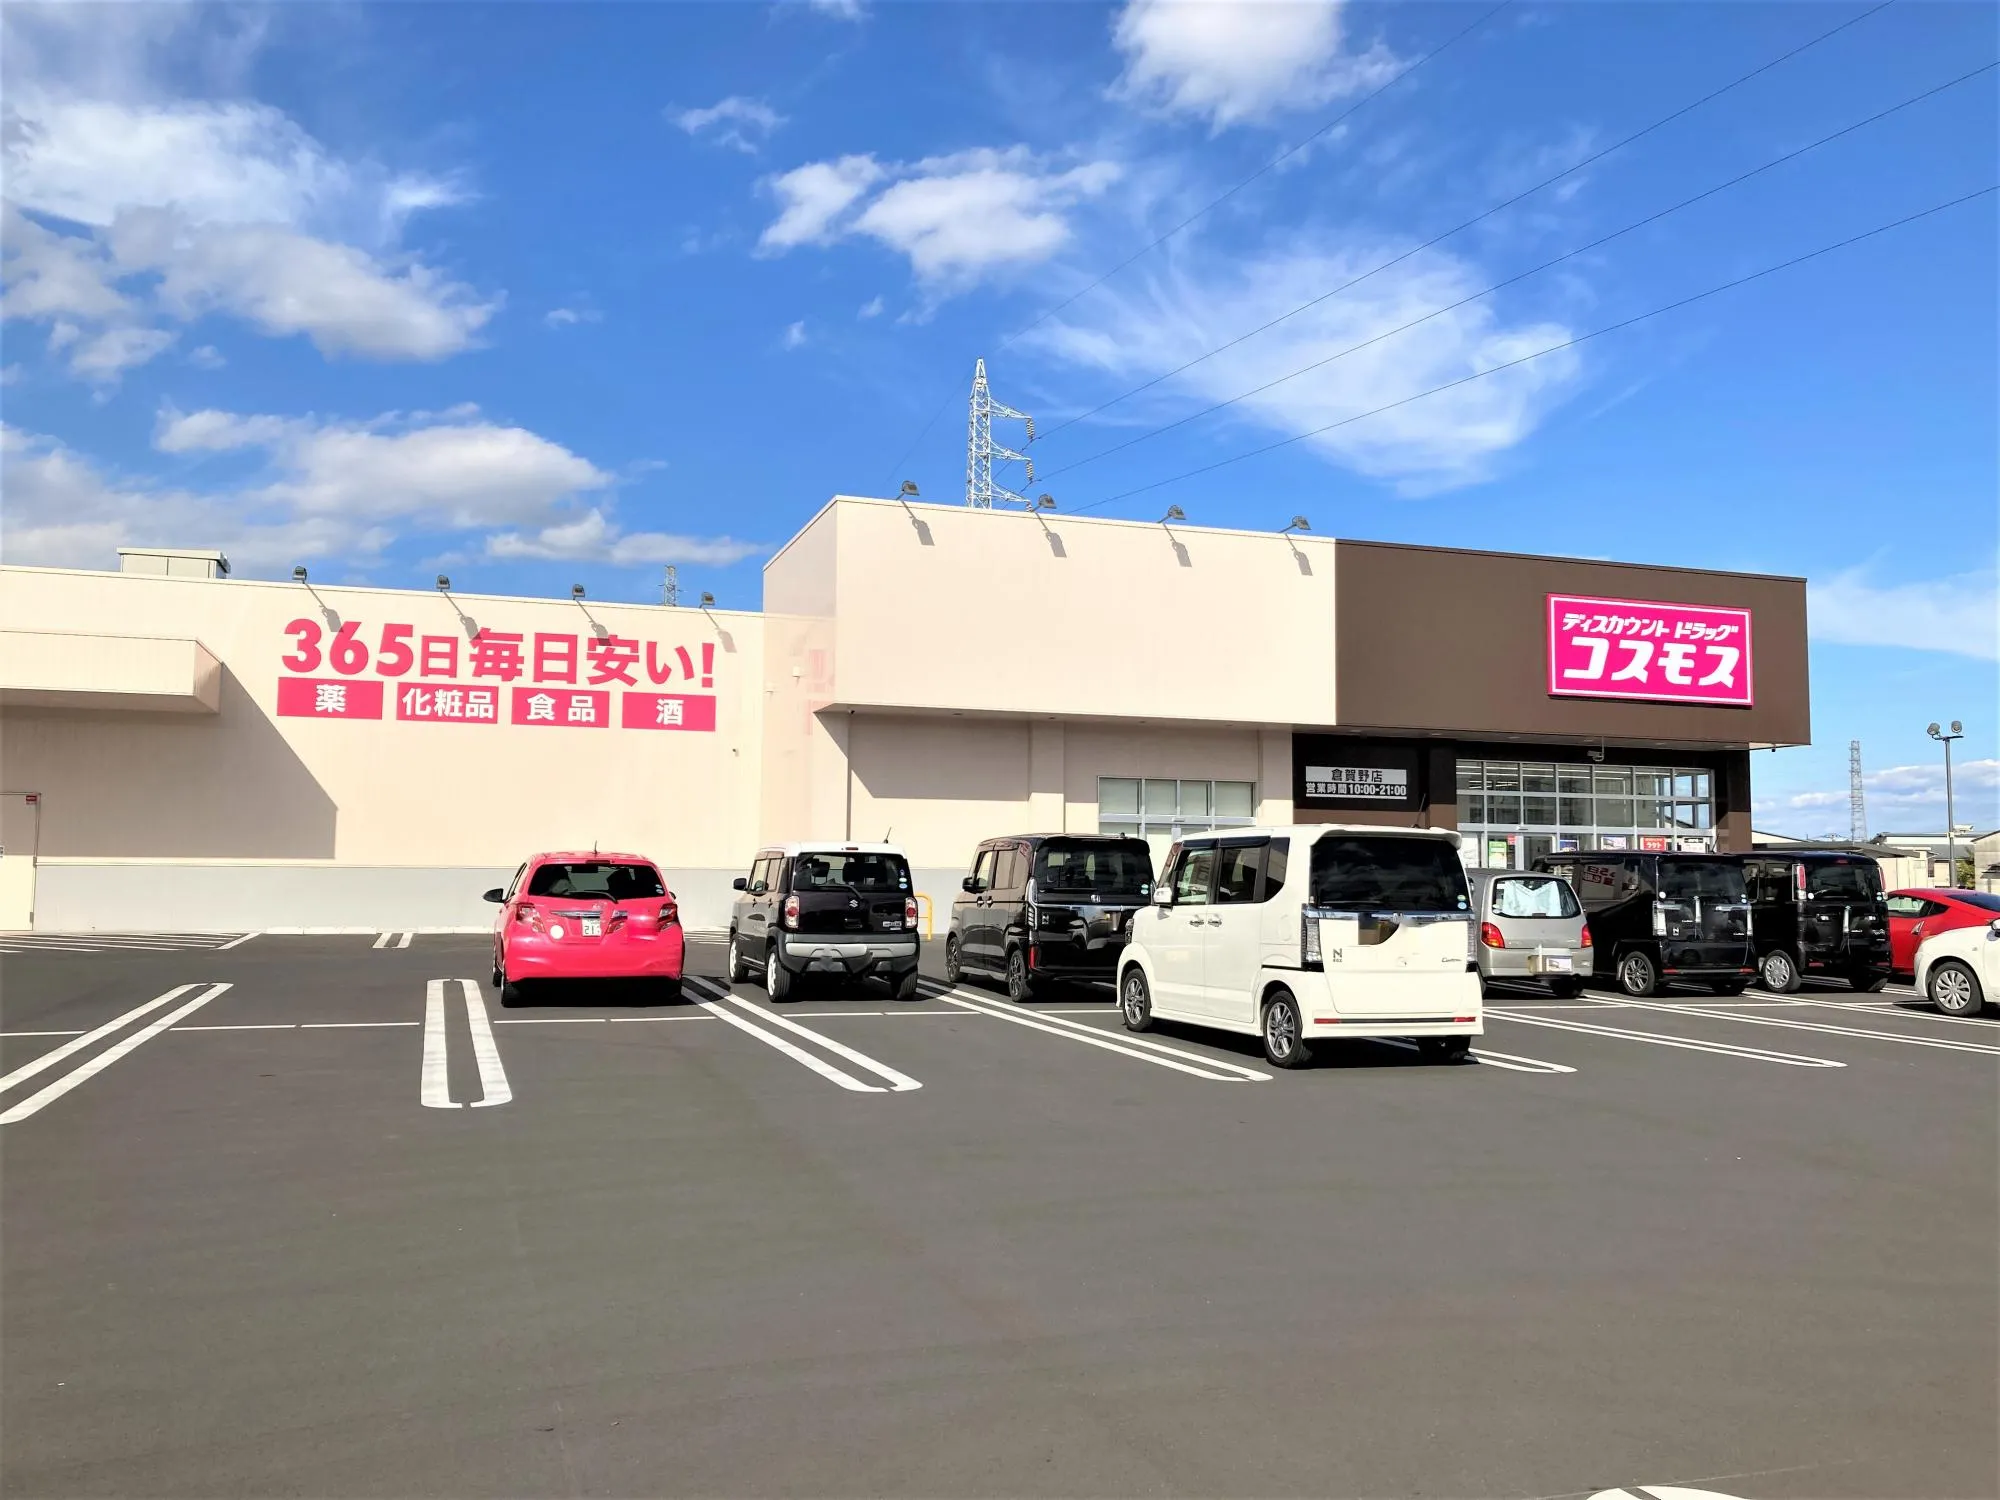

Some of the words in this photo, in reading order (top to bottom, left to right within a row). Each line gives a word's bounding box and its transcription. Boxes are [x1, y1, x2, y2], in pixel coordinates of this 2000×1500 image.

[1562, 612, 1670, 637] ディスカウント
[1674, 621, 1739, 641] ドラッグ
[281, 618, 716, 688] 365日毎日安い!
[1563, 636, 1740, 689] コスモス
[315, 684, 347, 714] 薬
[402, 688, 494, 720] 化粧品
[656, 698, 685, 726] 酒
[1331, 768, 1383, 783] 倉賀野店
